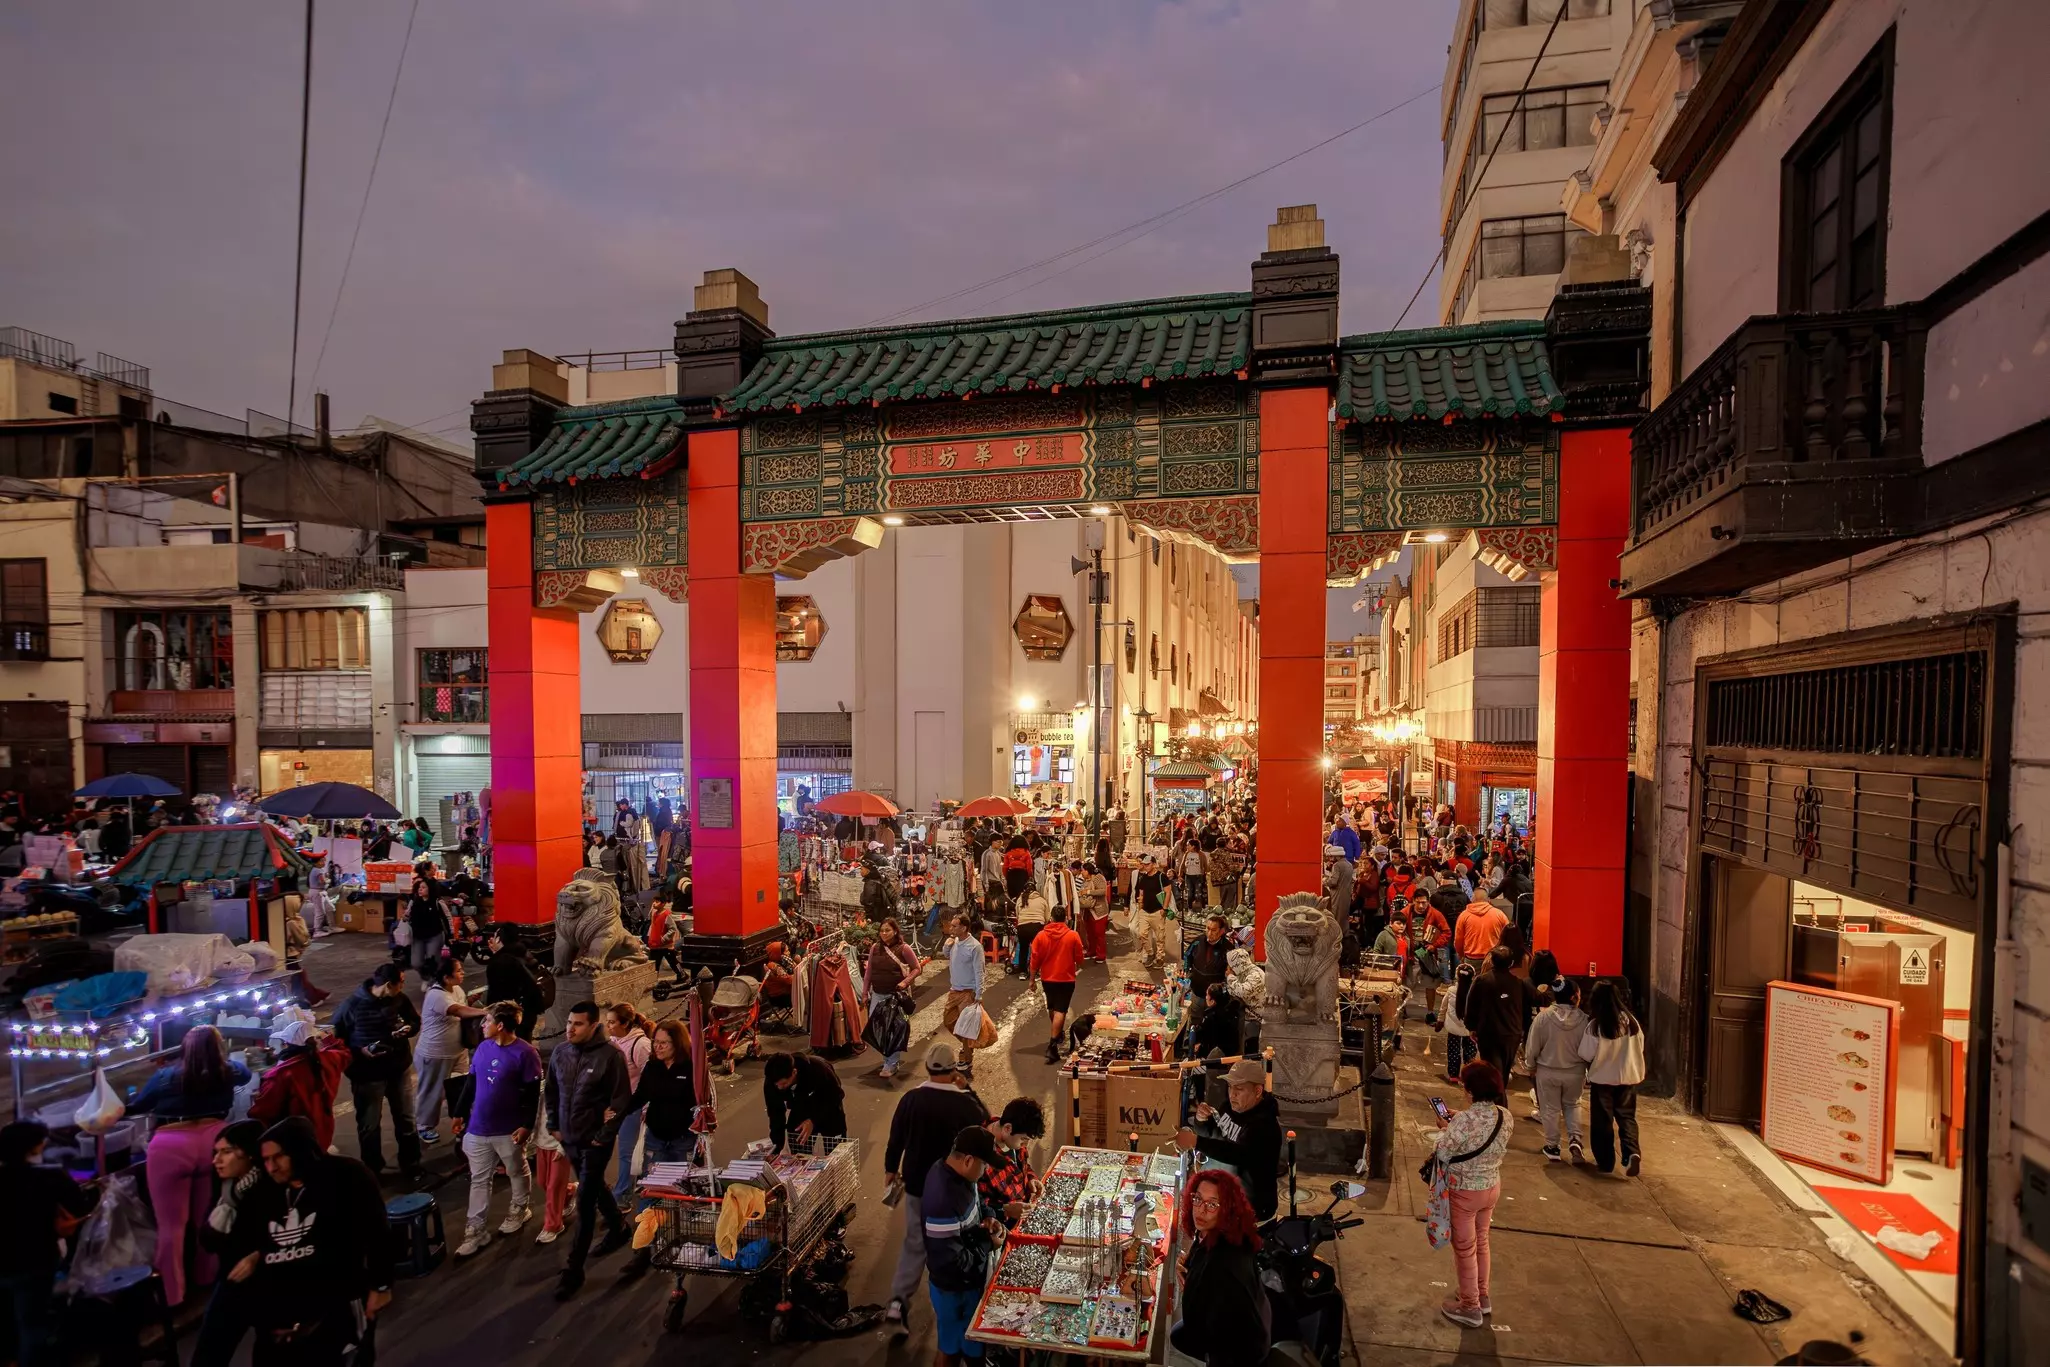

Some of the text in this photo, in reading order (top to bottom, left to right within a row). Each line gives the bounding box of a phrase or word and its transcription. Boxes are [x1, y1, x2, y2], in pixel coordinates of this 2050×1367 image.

[1040, 732, 1074, 741] bubble tea
[1797, 994, 1826, 1005] CHIFA
[1119, 1106, 1166, 1126] KEW
[265, 1245, 315, 1264] adidas
